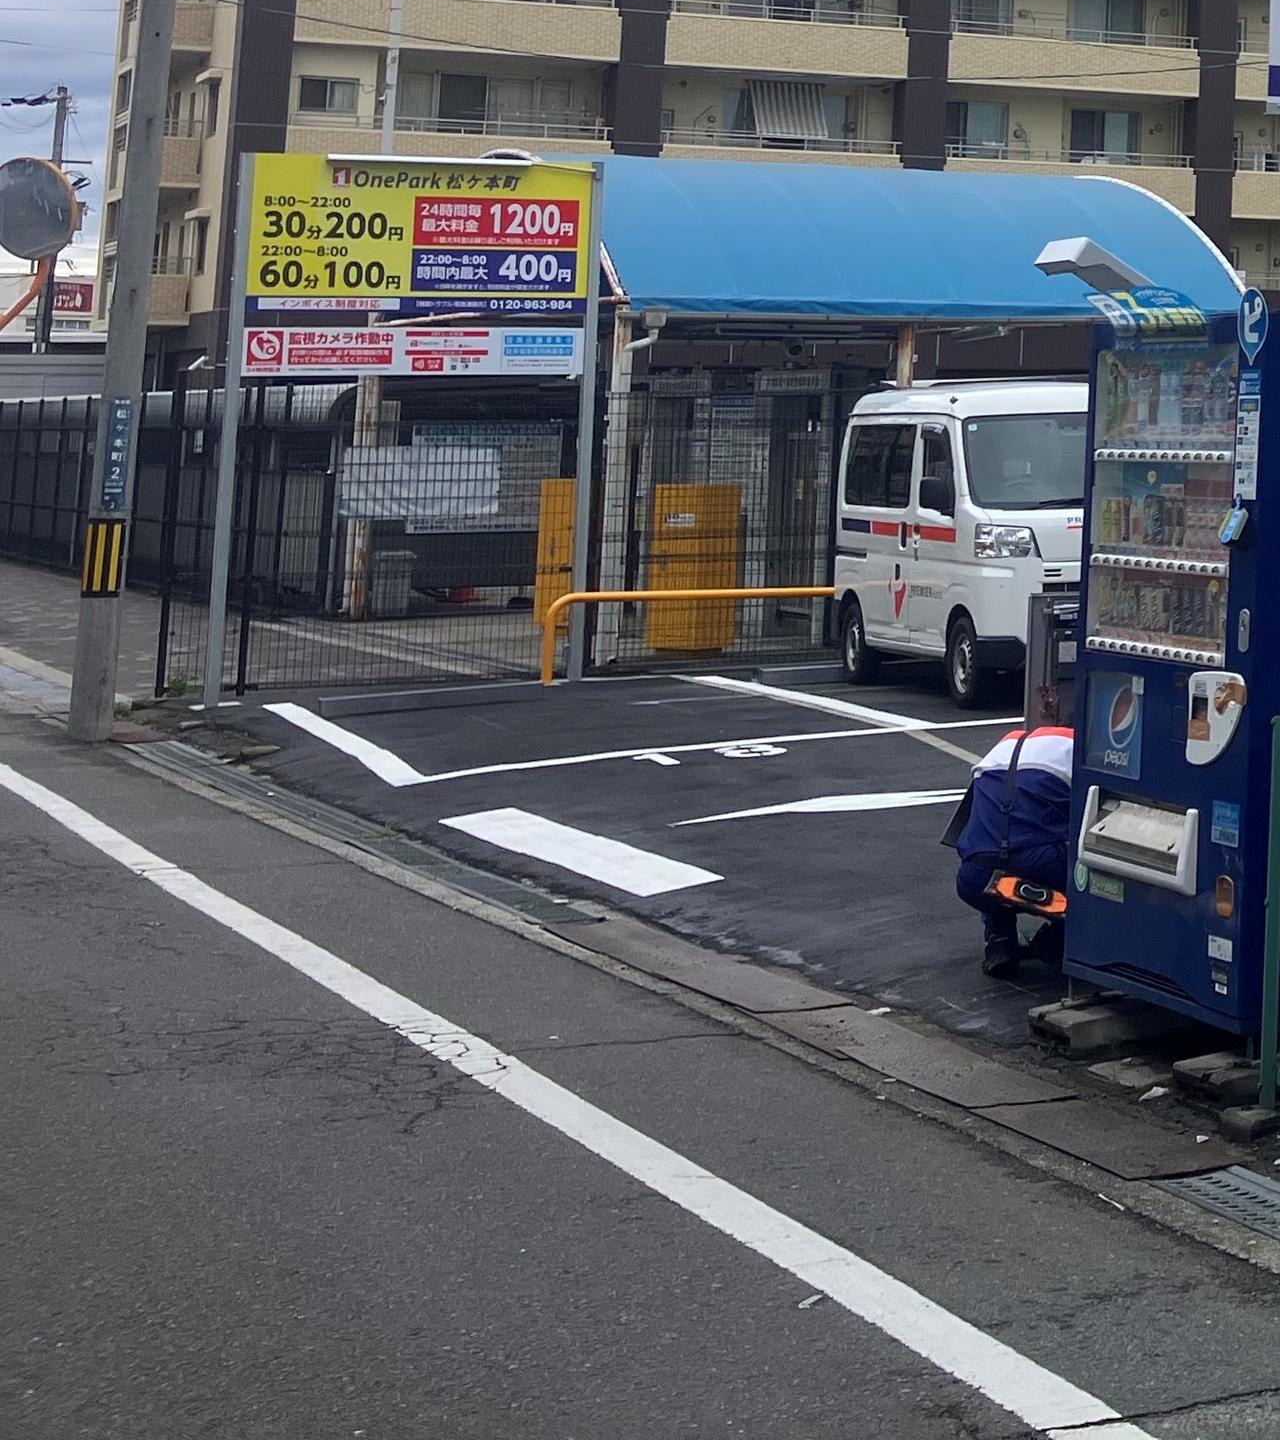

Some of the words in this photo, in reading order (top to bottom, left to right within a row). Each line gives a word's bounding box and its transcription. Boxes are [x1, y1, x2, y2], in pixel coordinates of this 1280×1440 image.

[354, 170, 443, 189] OnePark
[420, 203, 482, 217] 24時間毎
[422, 218, 479, 233] 最大料金
[490, 203, 574, 237] 1200円
[416, 266, 489, 280] 時間内最大
[498, 254, 572, 283] 400円
[279, 298, 381, 310] インボイス制度対応
[490, 300, 573, 311] 0120-963-984
[288, 332, 394, 346] 監視カメラ作動中
[1104, 747, 1129, 768] pepsi
